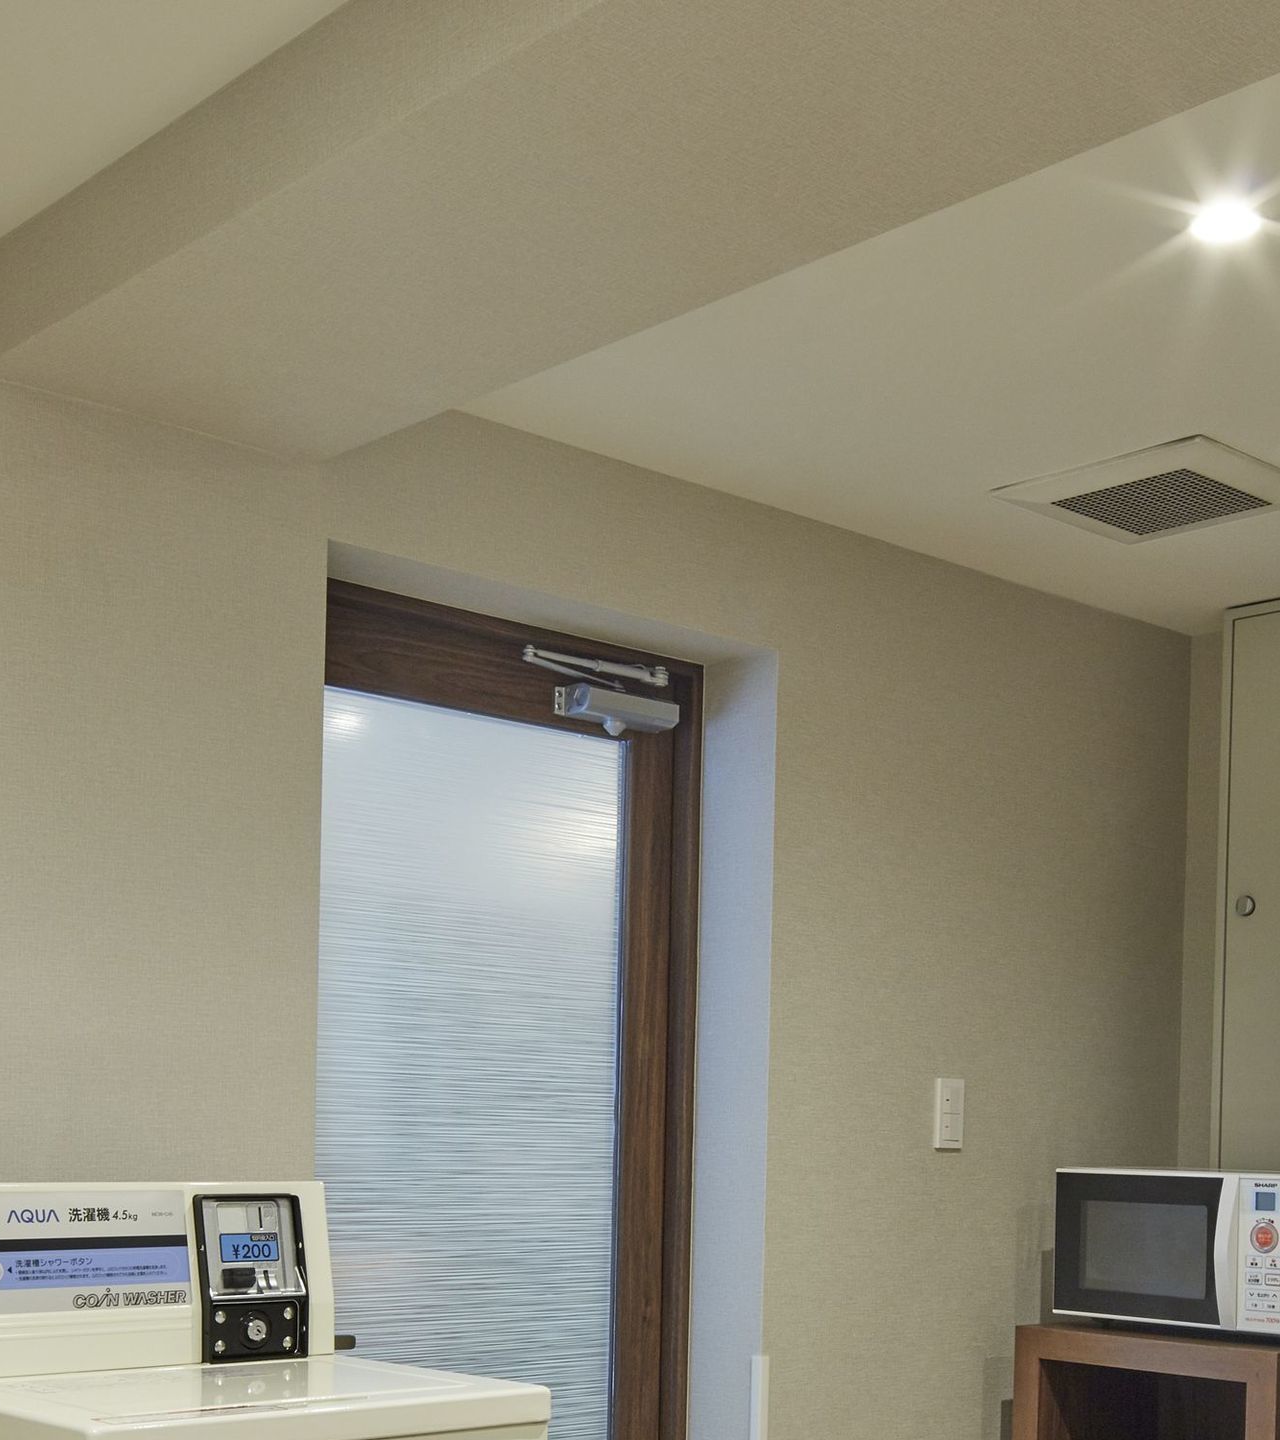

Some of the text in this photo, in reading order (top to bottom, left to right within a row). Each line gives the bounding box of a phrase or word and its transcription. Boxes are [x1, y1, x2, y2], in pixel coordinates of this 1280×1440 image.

[7, 1208, 60, 1224] AQUA
[68, 1207, 110, 1223] 洗濯機
[112, 1209, 138, 1222] 4.5kg
[232, 1243, 271, 1259] ¥200
[15, 1257, 93, 1268] 洗濯槽シャワーボタン
[123, 1290, 187, 1306] WASHER
